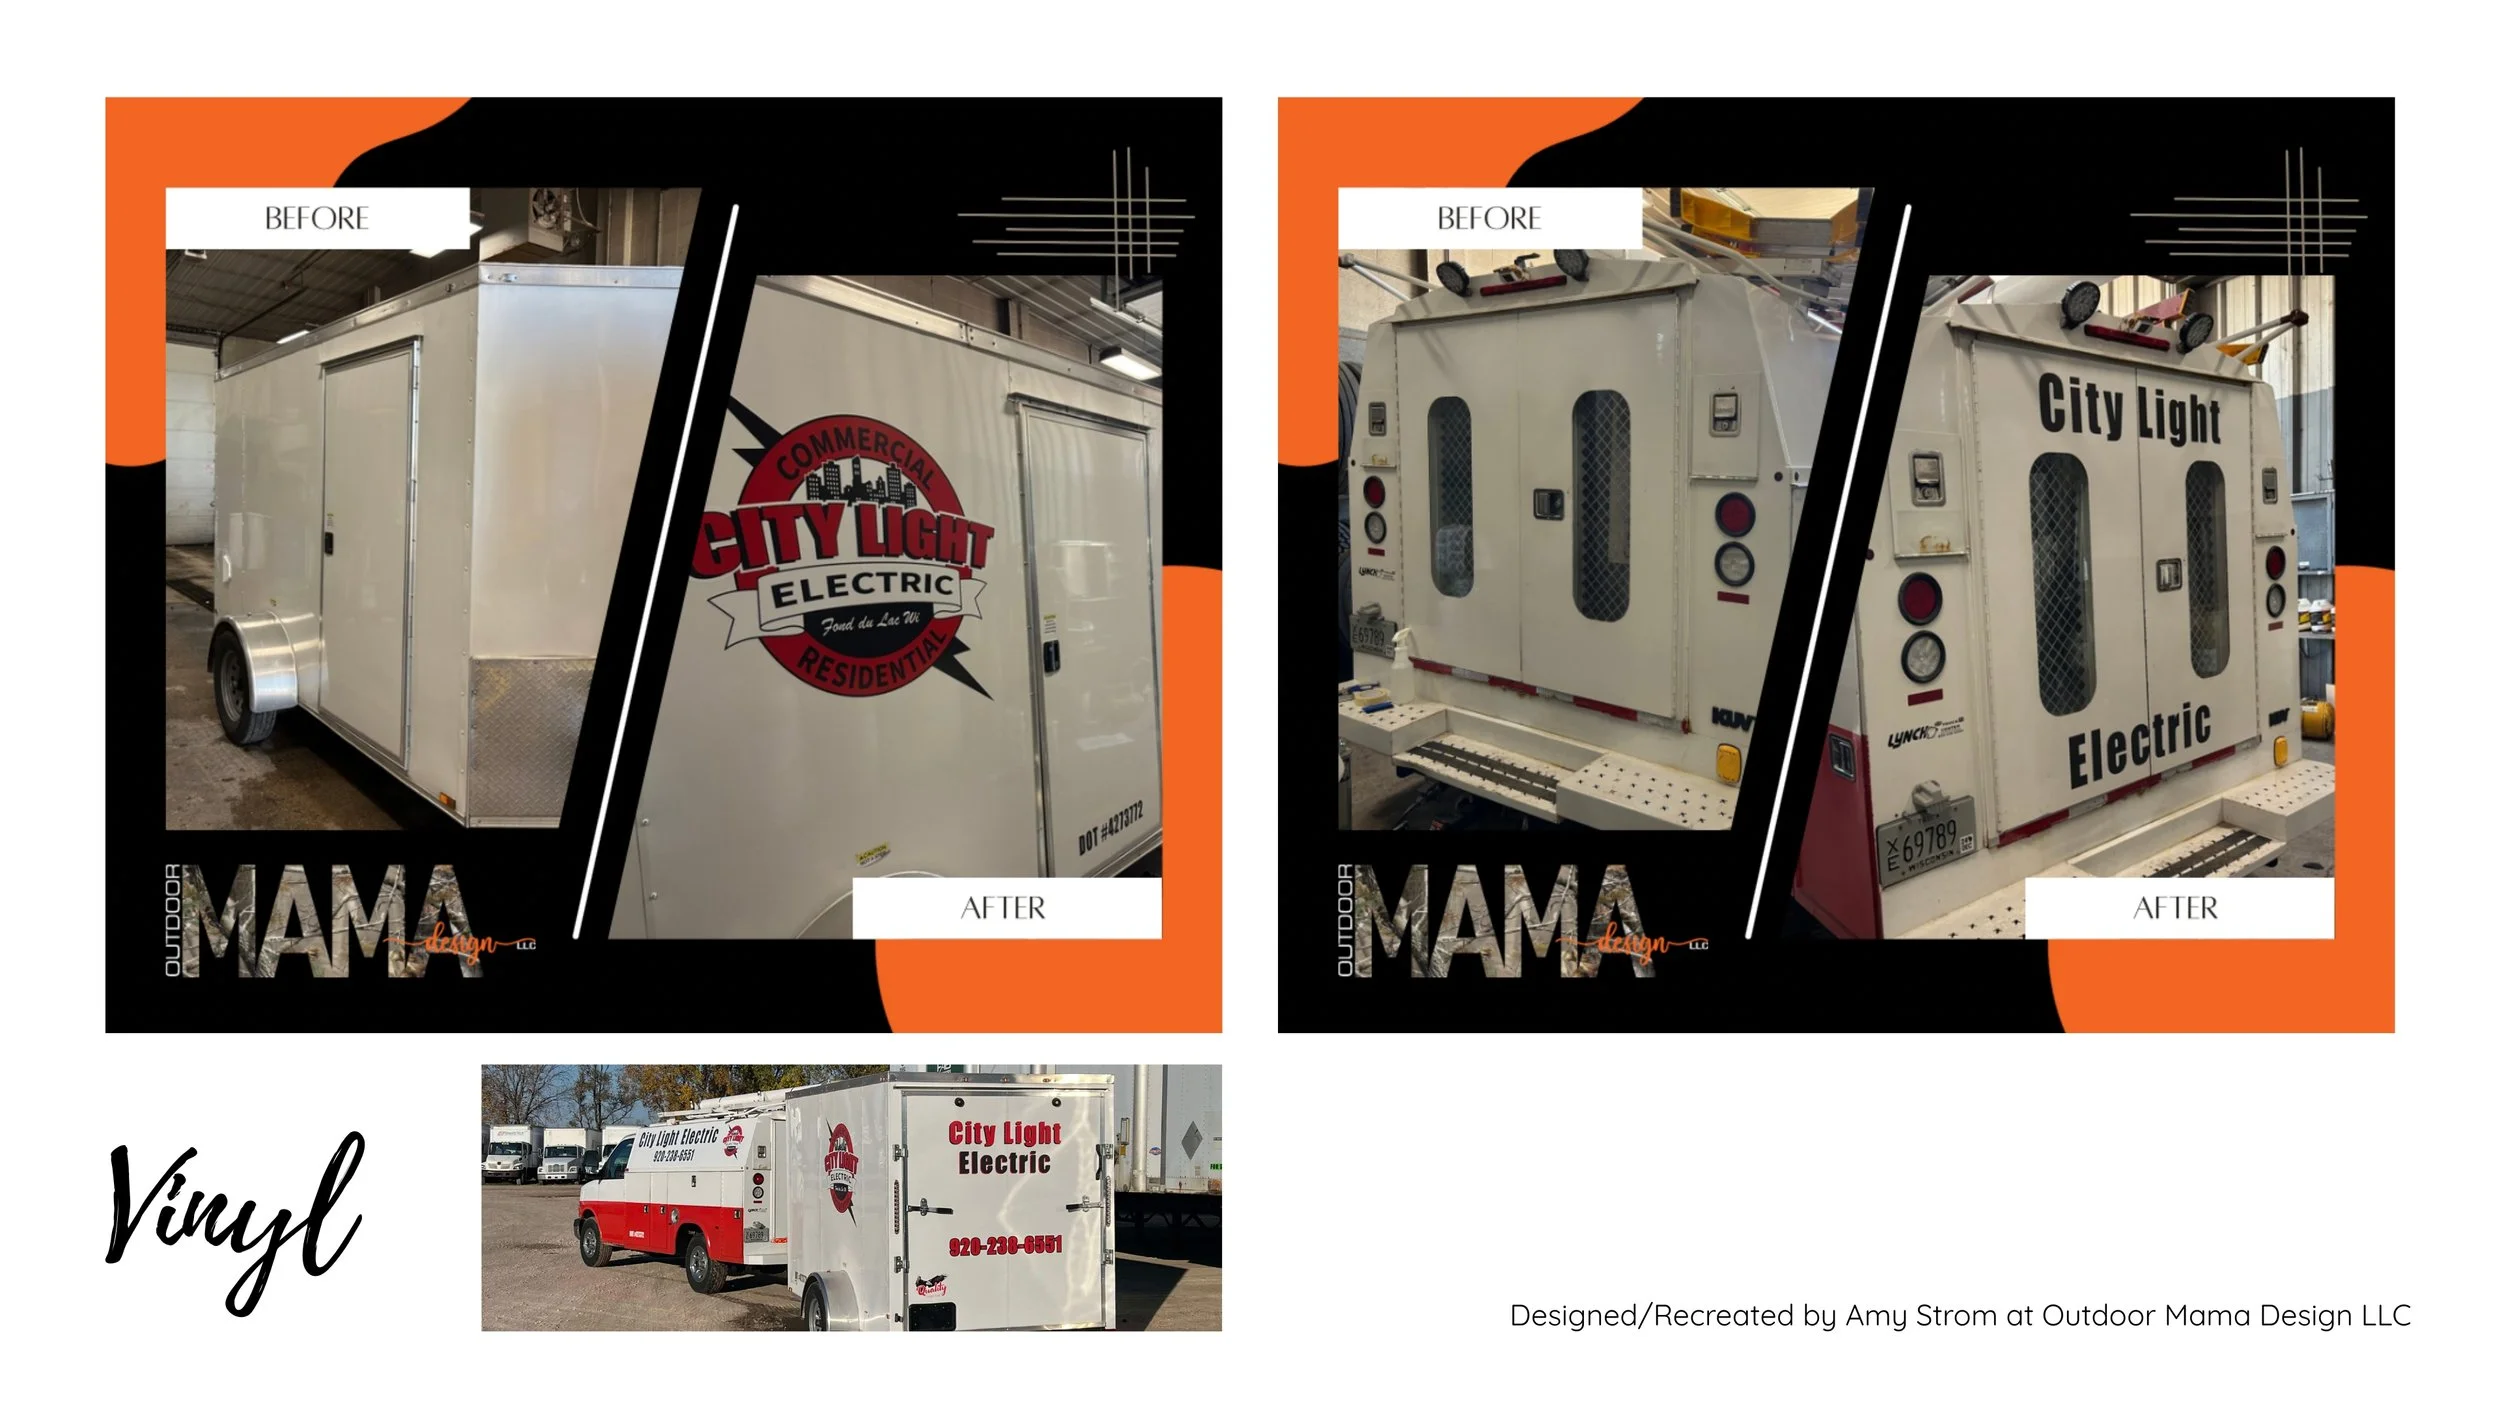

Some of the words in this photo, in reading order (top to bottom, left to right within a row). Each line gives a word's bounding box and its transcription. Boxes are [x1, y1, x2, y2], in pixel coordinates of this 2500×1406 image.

[2039, 373, 2123, 441] City
[2138, 386, 2221, 448] Light
[777, 426, 937, 490] COMMERCIAL
[690, 502, 845, 580] CITY
[854, 502, 995, 570] LIGHT
[771, 571, 955, 608] ELECTRIC
[821, 617, 855, 637] Fond
[858, 616, 873, 630] du
[877, 612, 900, 627] Lac
[903, 610, 920, 625] Wi
[797, 628, 947, 689] RESIDENTIAL
[1888, 725, 1928, 750] LYNCH
[2069, 702, 2211, 790] Electric
[1079, 826, 1098, 856] DOT
[1101, 800, 1144, 842] #4273772
[1903, 819, 1957, 863] 69789
[1908, 850, 1955, 873] WISCONSIN
[639, 1132, 657, 1149] City
[656, 1129, 680, 1148] Light
[681, 1126, 719, 1145] Electric
[948, 1120, 996, 1148] City
[1003, 1120, 1062, 1148] Light
[653, 1149, 695, 1162] 920-238-6551
[959, 1151, 1051, 1175] Electric
[831, 1172, 852, 1184] ELECTRIC
[949, 1235, 1062, 1257] 920-238-6551
